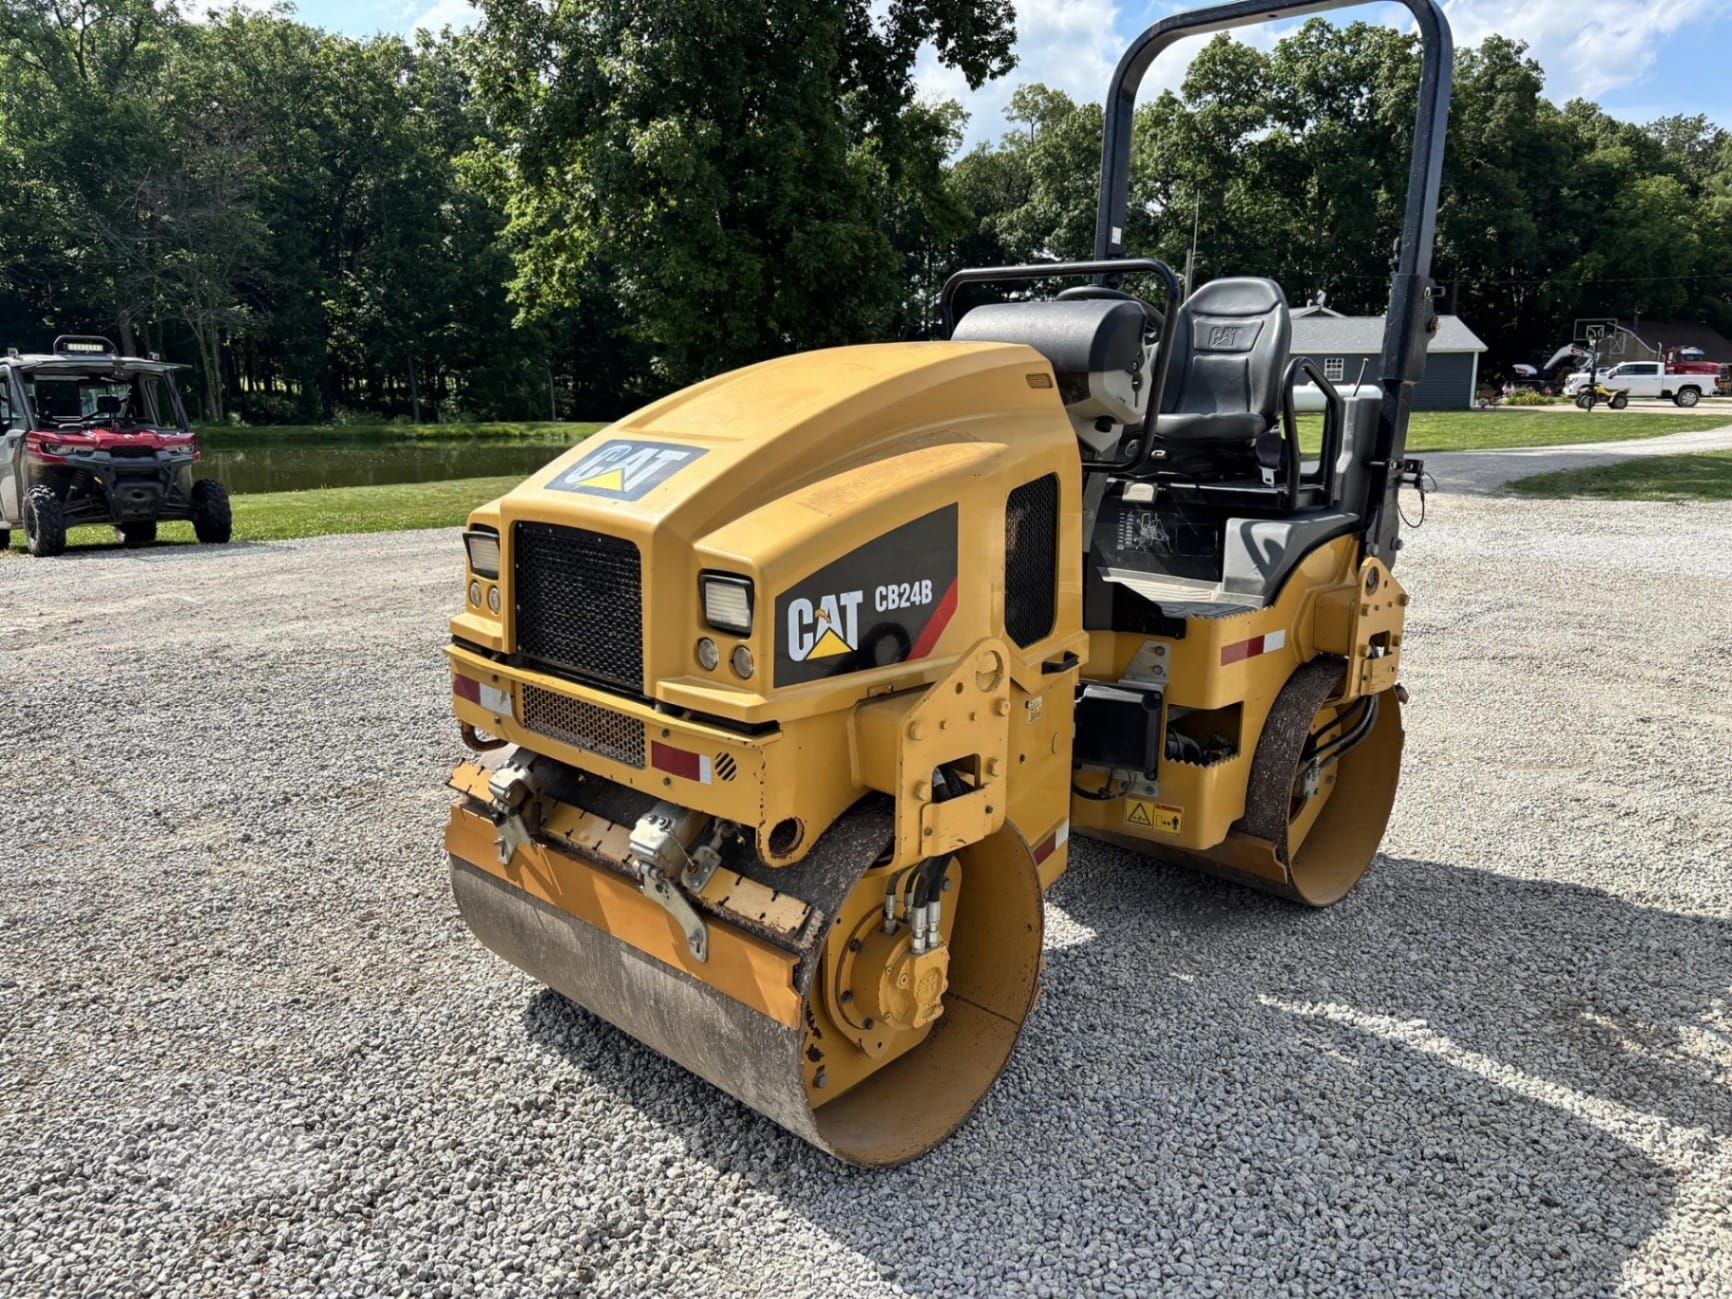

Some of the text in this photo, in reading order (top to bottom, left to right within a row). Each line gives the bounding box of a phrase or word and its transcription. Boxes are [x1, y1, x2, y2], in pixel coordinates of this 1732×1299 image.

[1208, 326, 1243, 348] CAT
[564, 444, 690, 492] CAT
[874, 579, 933, 613] CB24B
[787, 590, 863, 662] CAT
